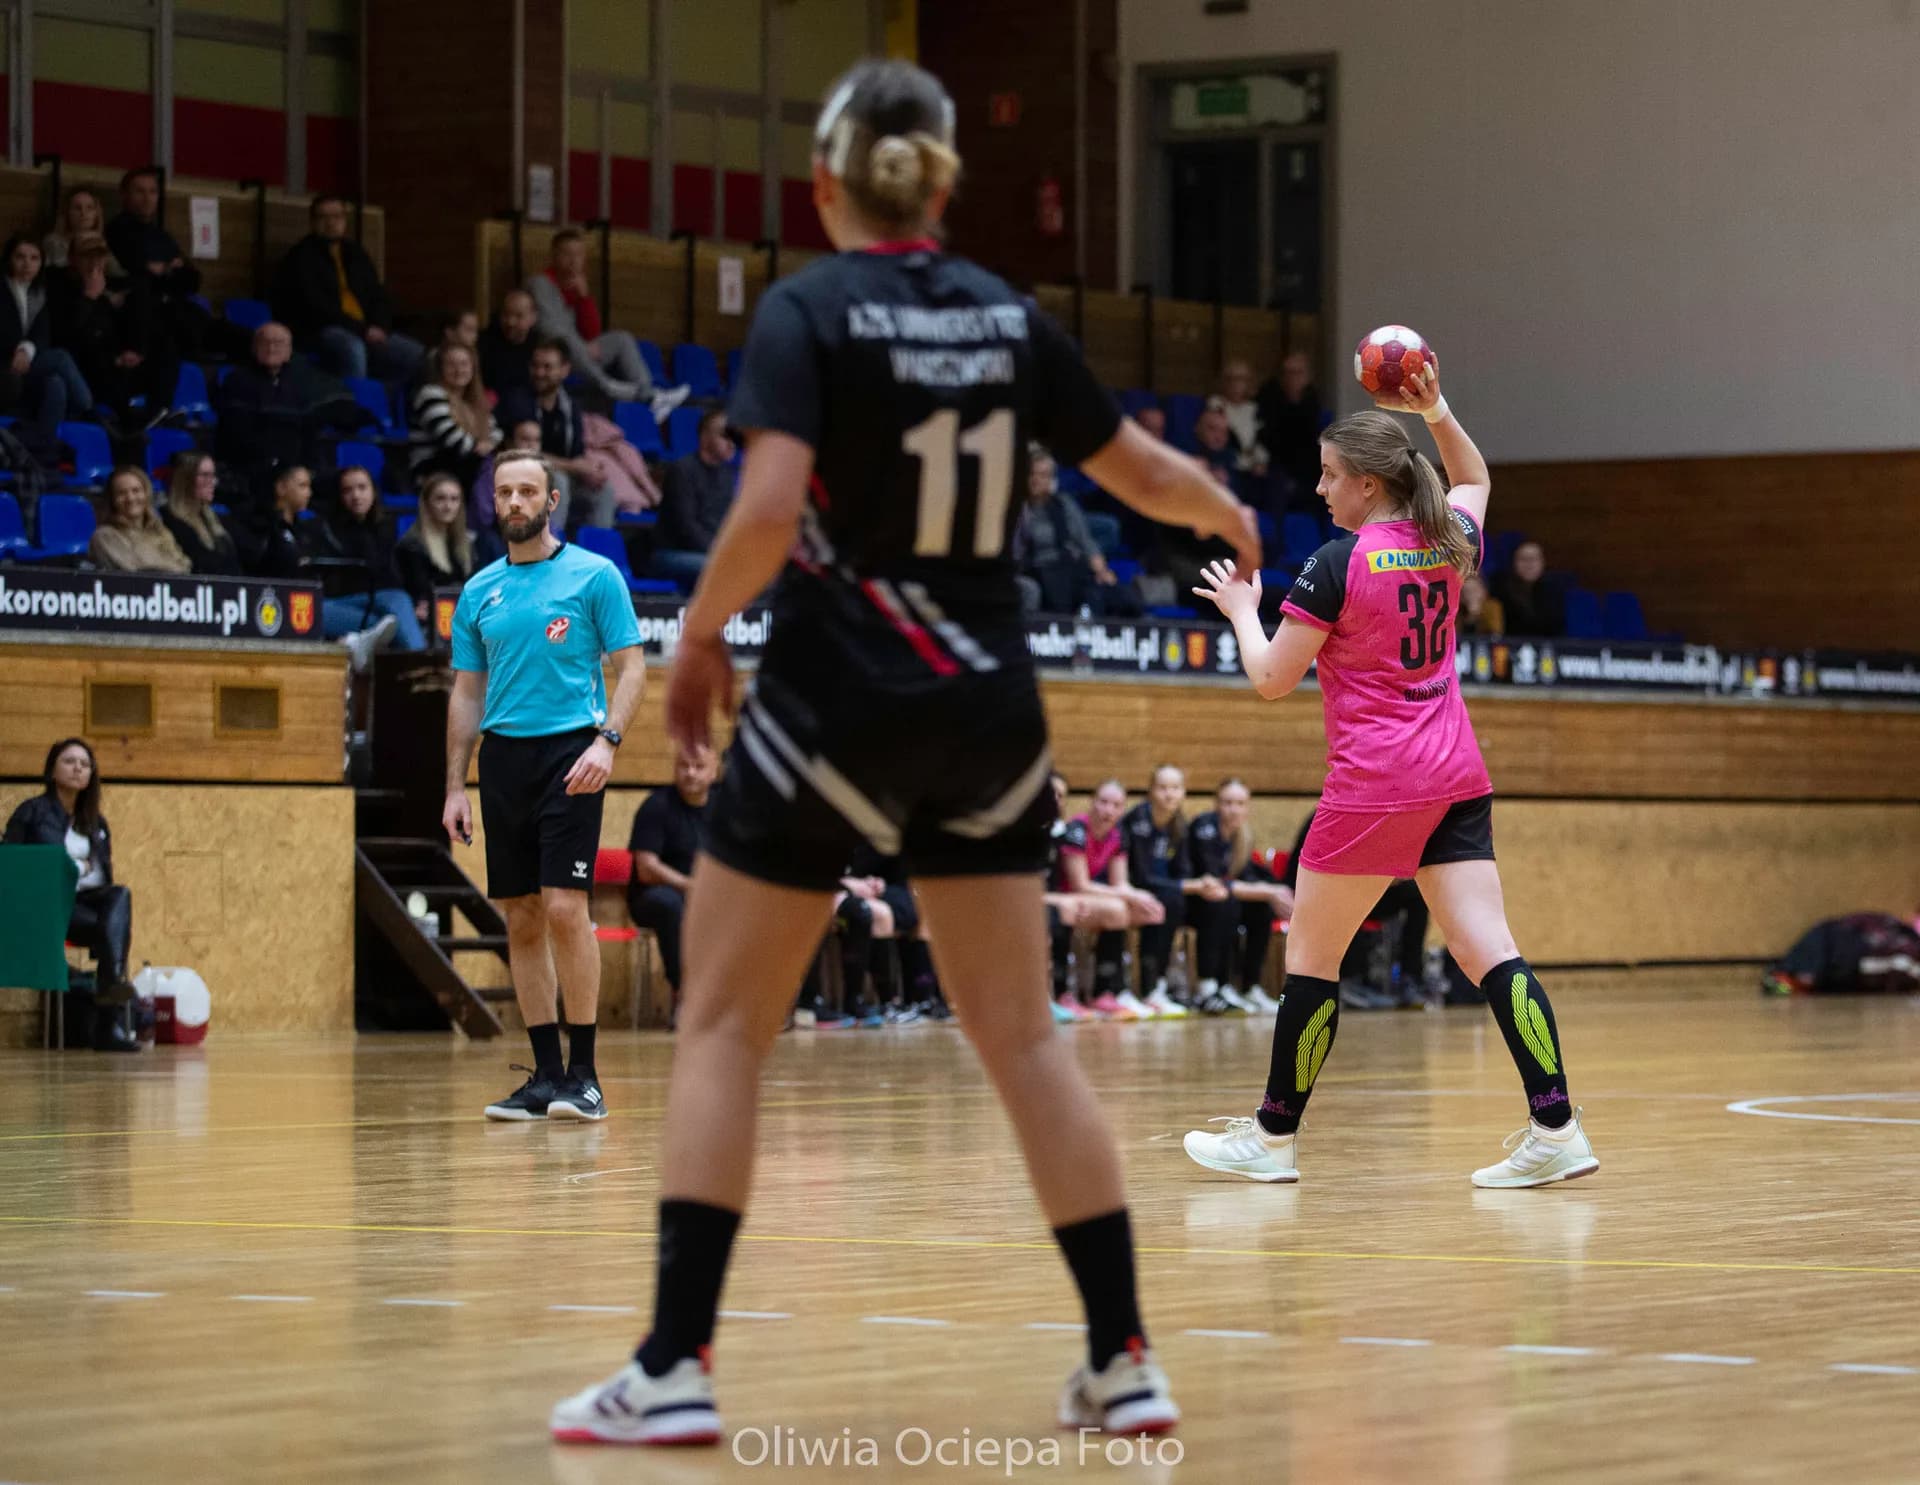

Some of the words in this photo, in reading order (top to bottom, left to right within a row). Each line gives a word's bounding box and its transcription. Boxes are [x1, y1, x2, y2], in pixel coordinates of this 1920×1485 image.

[902, 408, 1015, 557] 11
[0, 576, 248, 636] koronahandball.pl
[1398, 580, 1450, 671] 32
